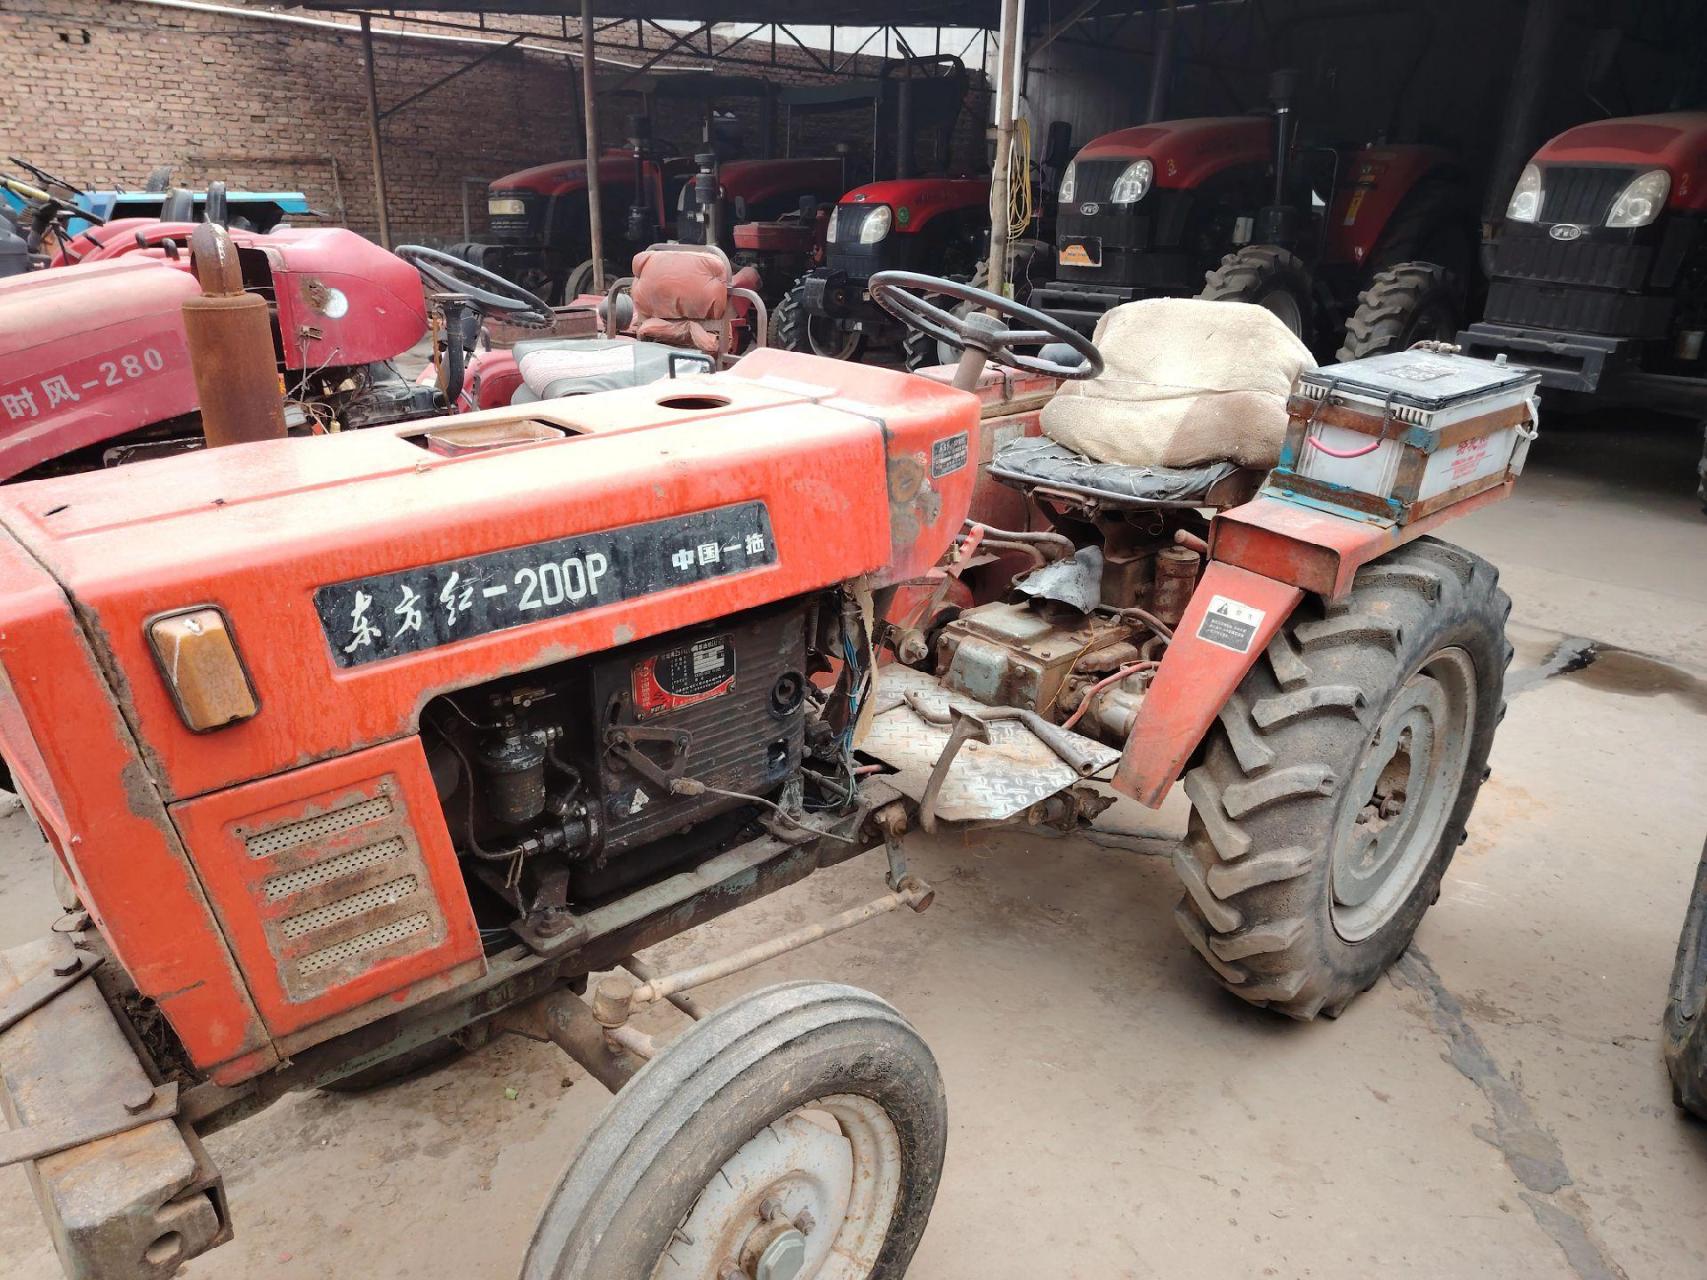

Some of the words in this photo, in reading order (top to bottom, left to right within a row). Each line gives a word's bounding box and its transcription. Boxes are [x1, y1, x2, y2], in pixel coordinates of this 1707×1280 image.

[2, 348, 164, 419] 时风-280
[671, 532, 767, 571] 中国一拖
[344, 552, 609, 654] 东方红-200P
